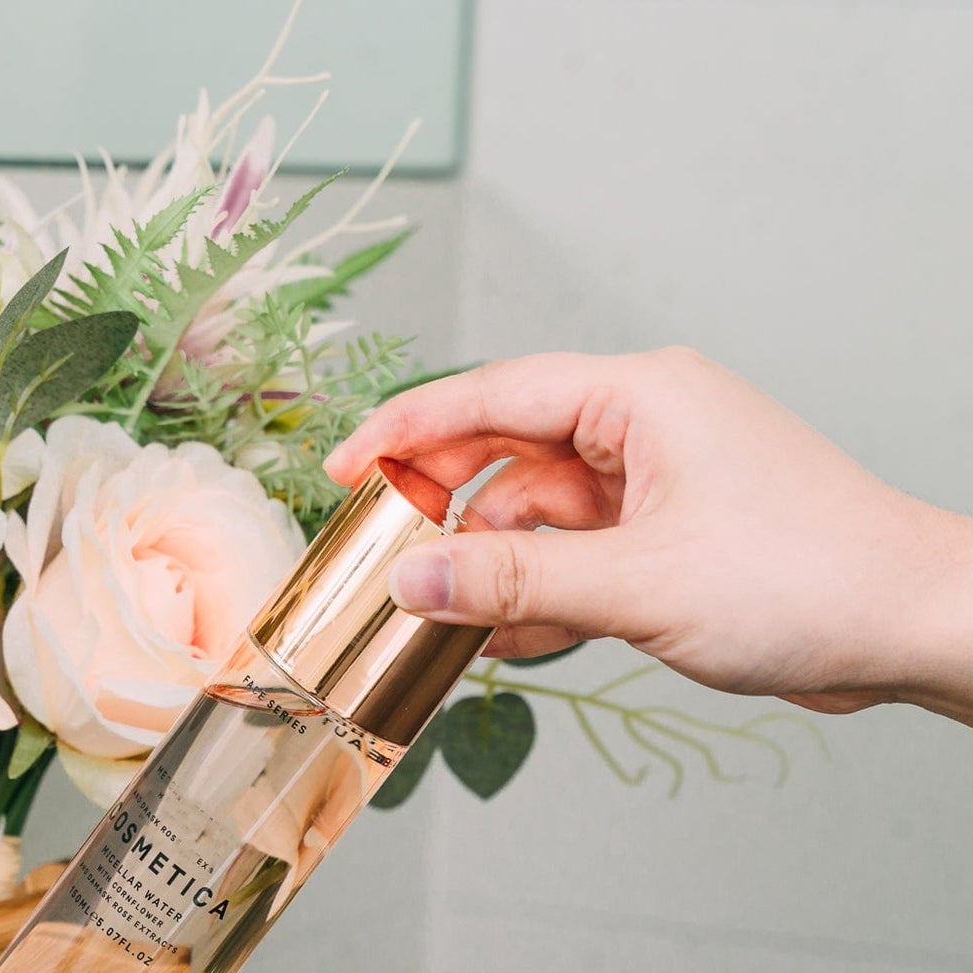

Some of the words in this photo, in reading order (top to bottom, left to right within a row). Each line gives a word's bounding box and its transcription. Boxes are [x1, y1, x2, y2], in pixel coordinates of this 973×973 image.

[243, 674, 266, 700] FACE
[267, 700, 307, 735] SERIES
[96, 863, 113, 883] WITH
[112, 881, 164, 928] CORNFLOWER
[100, 845, 142, 891] MICELLAR
[144, 889, 183, 922] WATER
[109, 801, 230, 920] COSMETICA
[87, 873, 112, 903] DAMASK
[112, 902, 132, 922] ROSE
[133, 921, 178, 954] EXTRACTS
